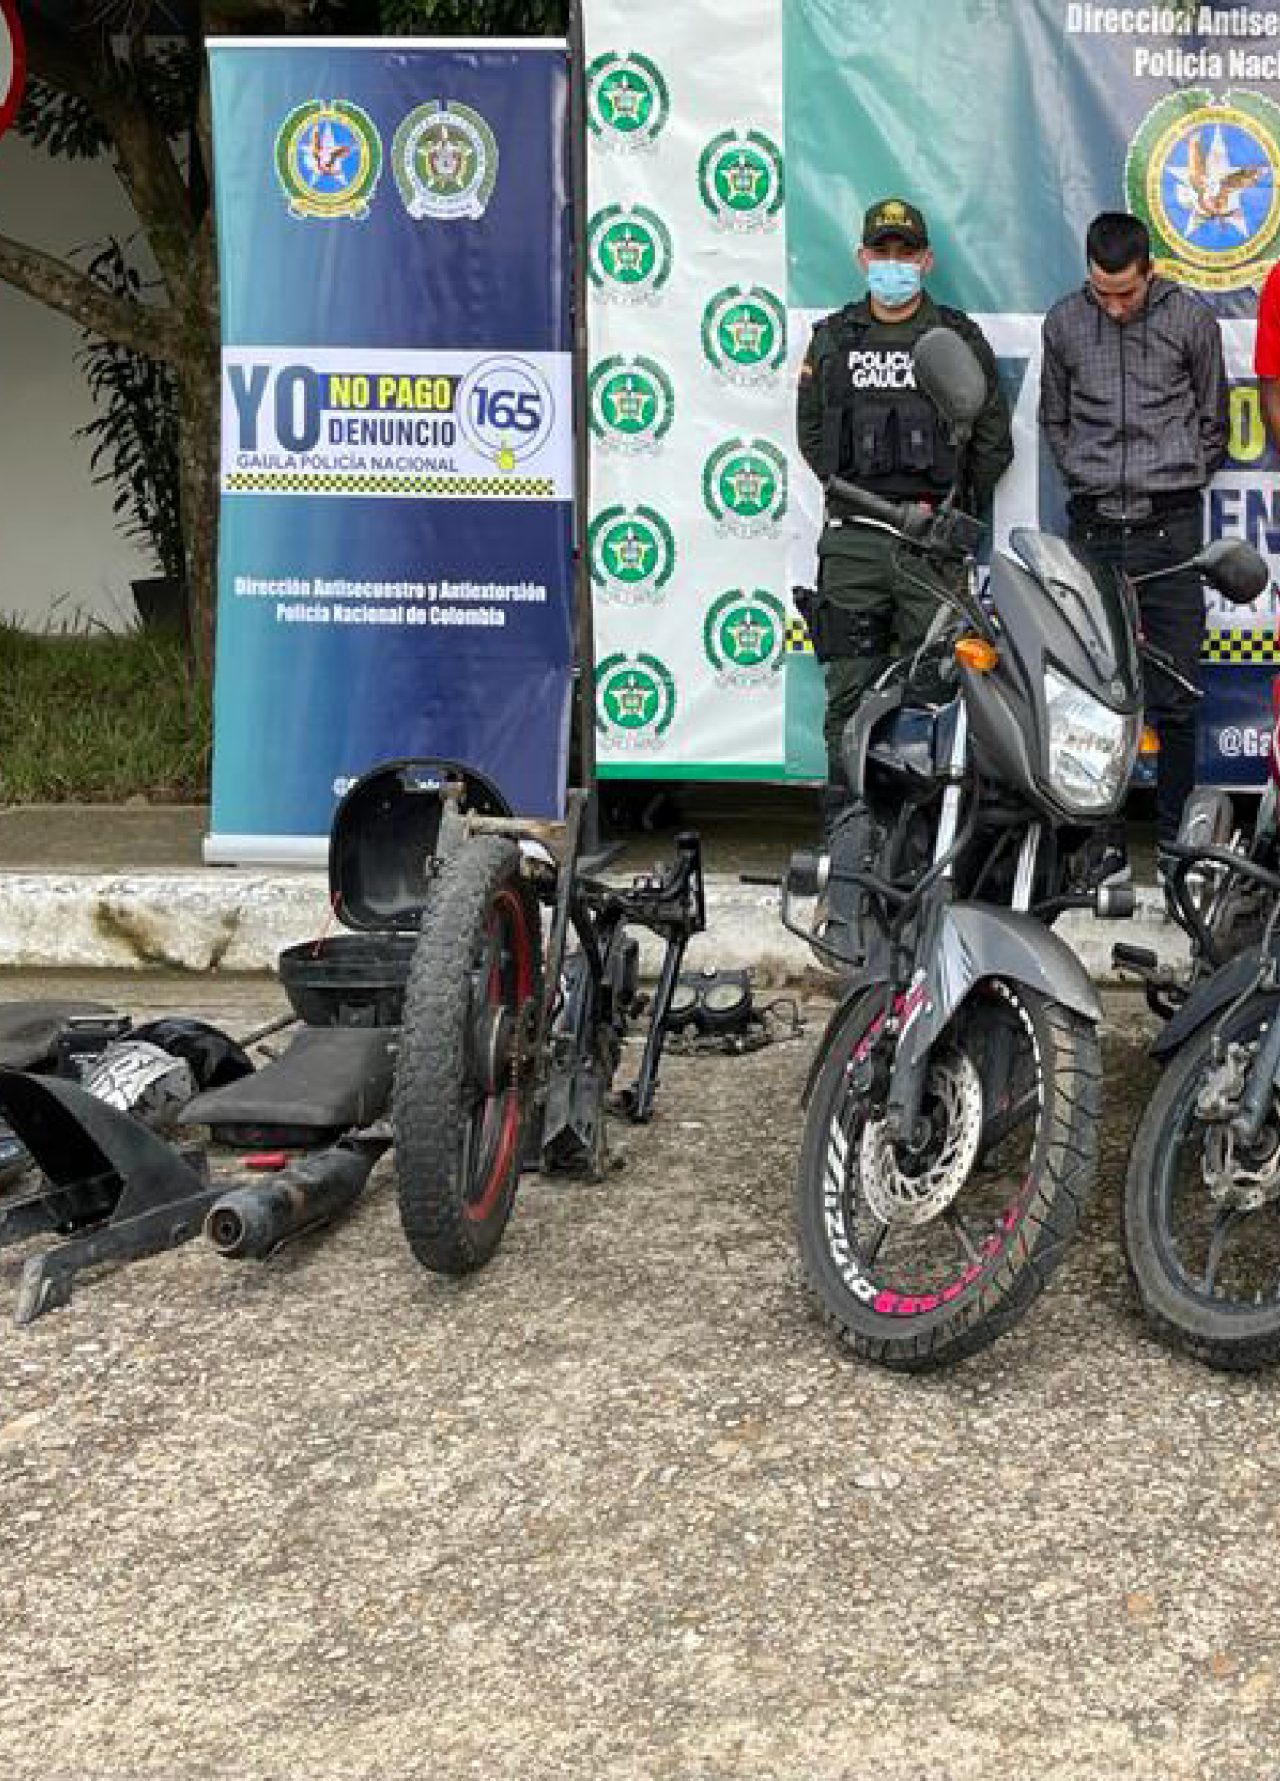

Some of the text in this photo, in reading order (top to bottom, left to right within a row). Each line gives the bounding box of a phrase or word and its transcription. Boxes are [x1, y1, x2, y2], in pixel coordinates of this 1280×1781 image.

[1134, 47, 1222, 79] Policía
[329, 374, 452, 410] NO PAGO
[852, 368, 918, 389] GAULA
[228, 364, 322, 454] YO
[471, 386, 542, 432] 165
[328, 418, 458, 446] DENUNCIO
[236, 454, 297, 470] GAULA
[371, 456, 459, 473] NACIONAL
[406, 606, 427, 624] de
